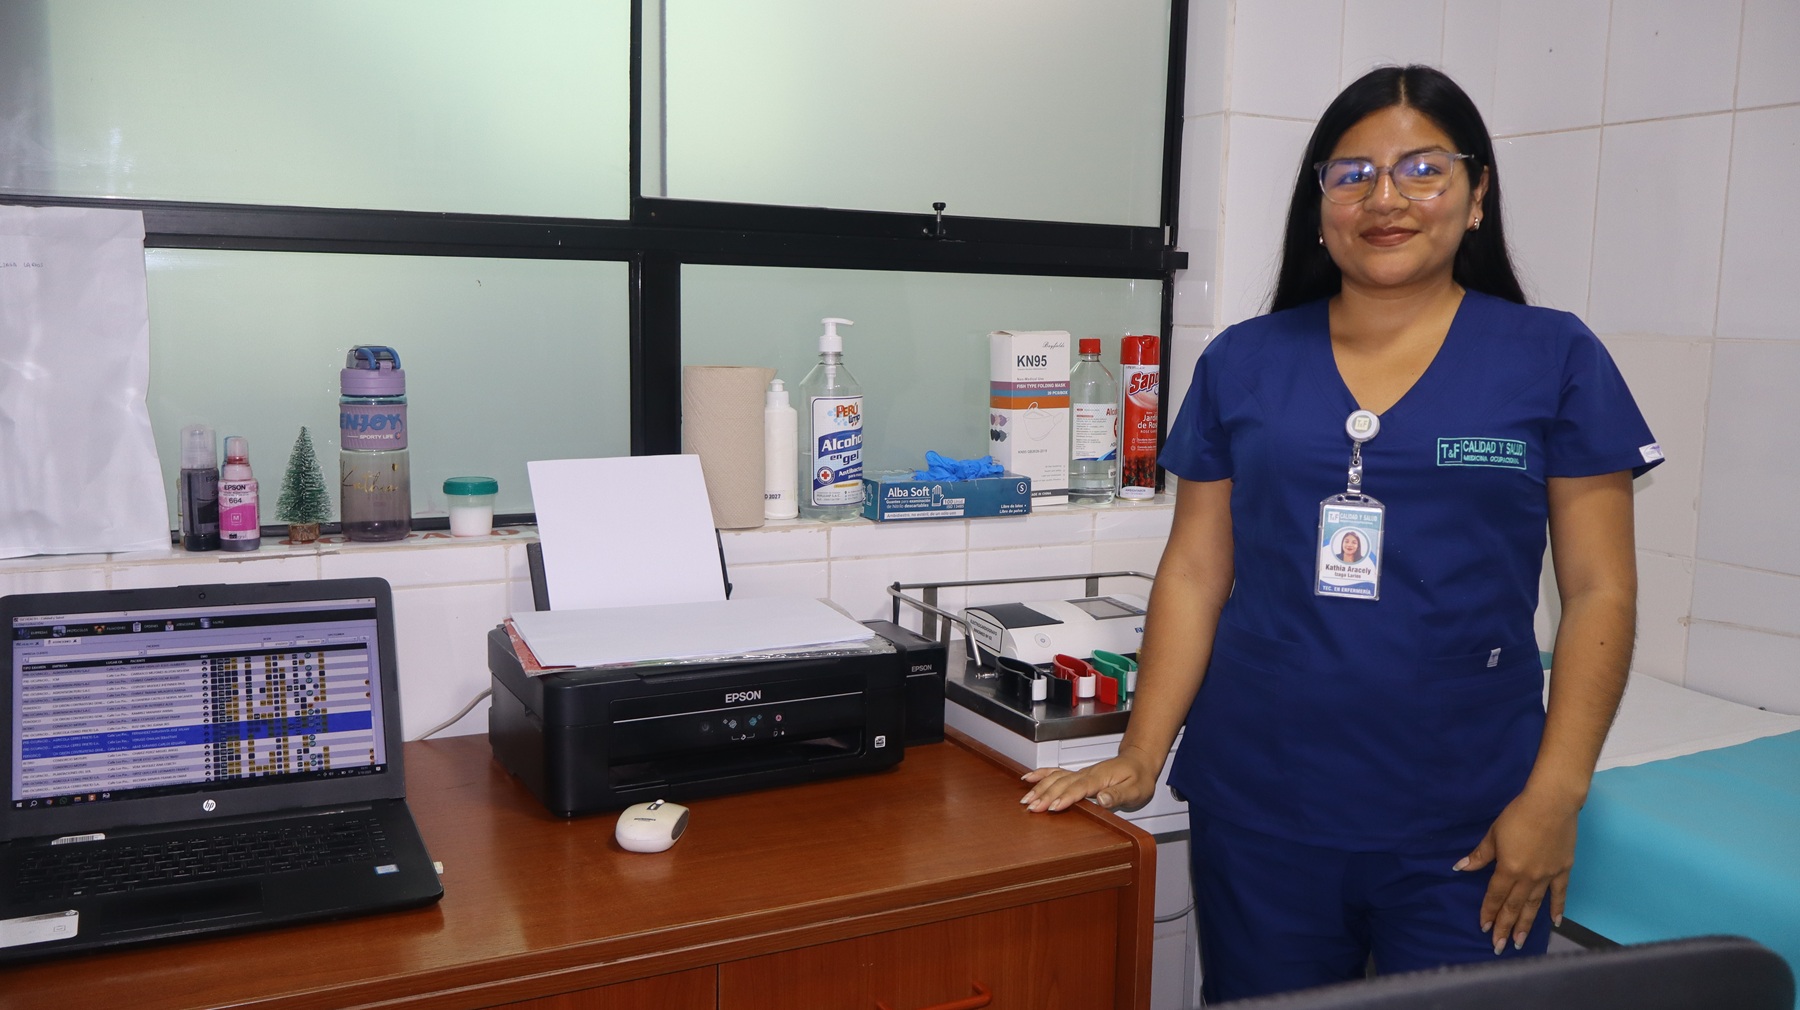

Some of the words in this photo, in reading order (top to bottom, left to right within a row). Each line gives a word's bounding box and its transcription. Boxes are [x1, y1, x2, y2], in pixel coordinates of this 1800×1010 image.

[1017, 355, 1048, 368] KN95
[836, 402, 859, 418] PERÚ
[340, 412, 403, 433] ENJOY
[1441, 443, 1461, 459] T&F
[1462, 440, 1497, 454] CALIDAD
[1499, 442, 1504, 454] Y
[1506, 442, 1523, 456] SALUD
[842, 450, 859, 465] gel
[887, 488, 909, 498] Alba
[910, 486, 930, 497] Soft
[1340, 512, 1358, 520] CALIDAD
[1363, 514, 1378, 522] SALUD
[1325, 564, 1346, 572] Kathia
[1347, 566, 1371, 575] Aracely
[911, 664, 932, 673] EPSON
[725, 690, 761, 703] EPSON
[204, 799, 215, 811] hp
